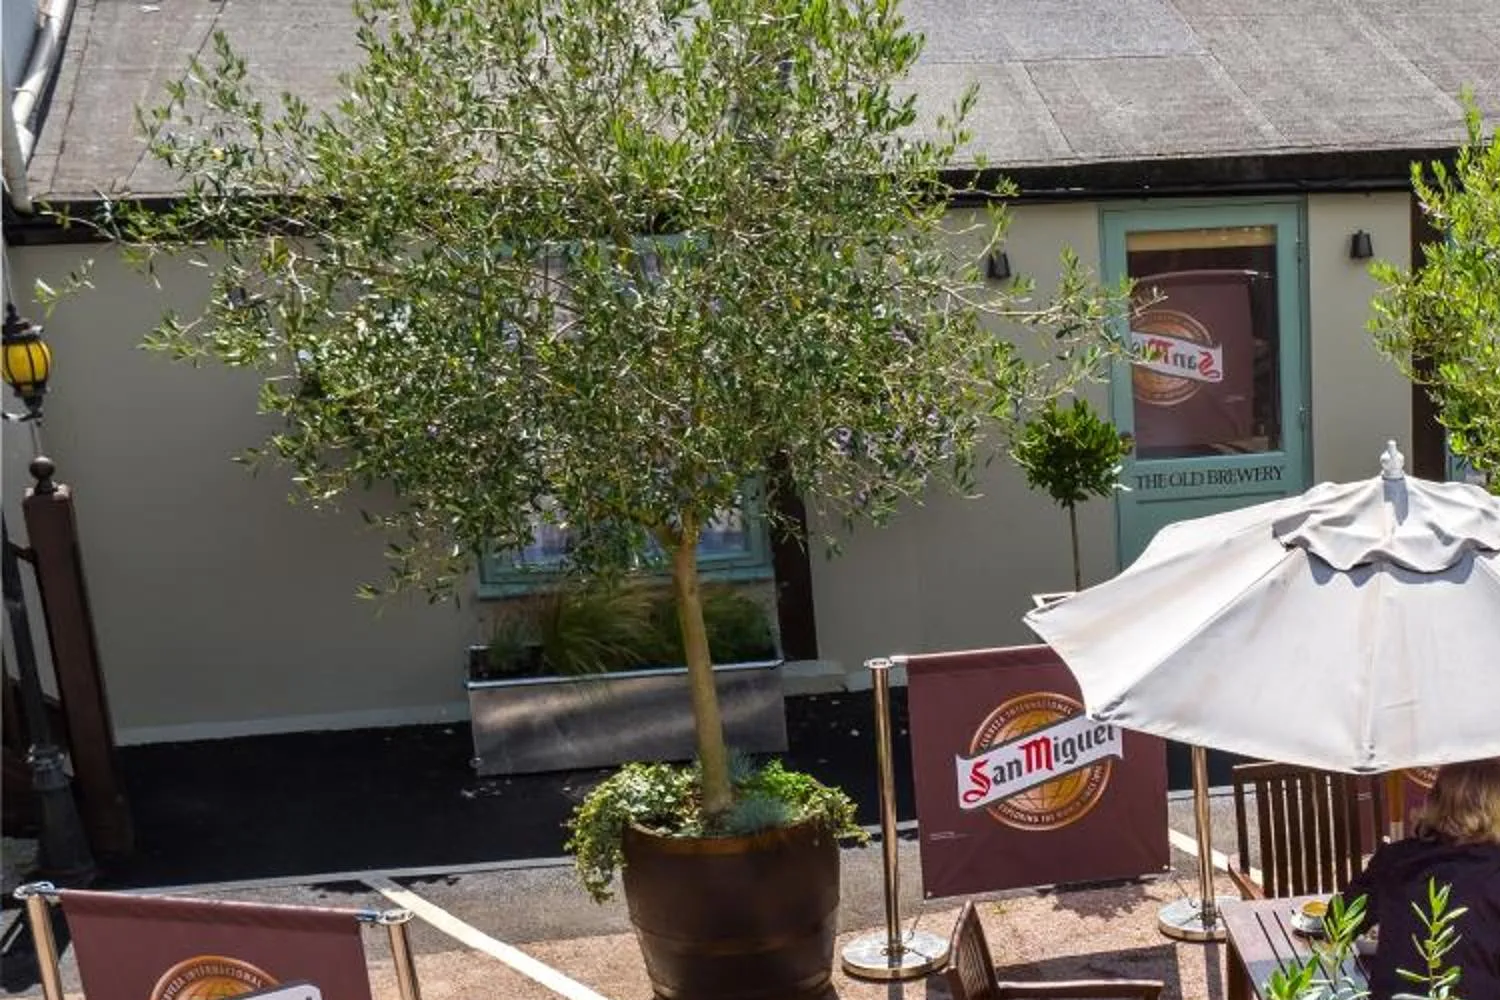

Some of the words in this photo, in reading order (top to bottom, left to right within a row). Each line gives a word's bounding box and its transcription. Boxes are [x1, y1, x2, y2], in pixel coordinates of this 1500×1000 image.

[1133, 473, 1168, 490] THE
[1169, 471, 1205, 487] OLD
[1207, 464, 1284, 485] BREWERY
[963, 758, 1023, 802] San
[1018, 724, 1114, 773] Miguel
